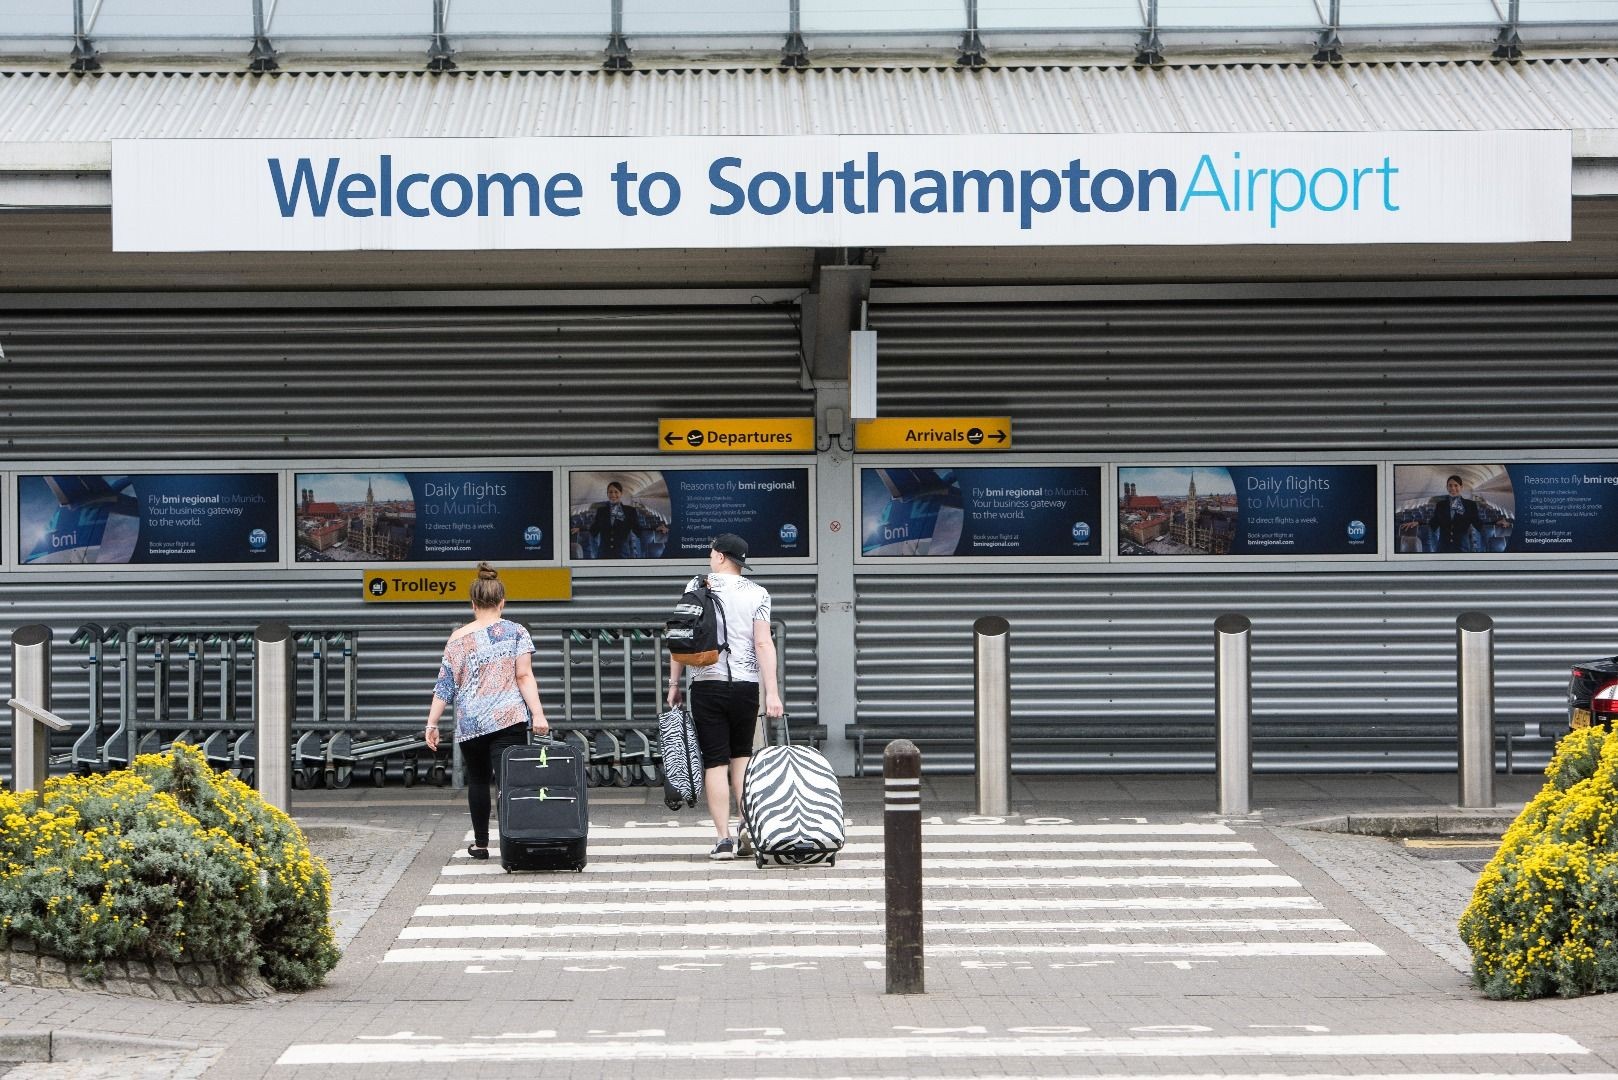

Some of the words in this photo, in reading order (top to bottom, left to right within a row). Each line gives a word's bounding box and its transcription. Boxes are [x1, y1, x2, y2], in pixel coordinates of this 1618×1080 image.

[267, 154, 583, 218] Welcome
[610, 161, 681, 217] to
[707, 431, 793, 446] Departures
[905, 429, 965, 442] Arrivals
[680, 481, 714, 490] Reasons
[716, 482, 725, 490] to
[726, 480, 736, 492] fly
[738, 480, 756, 490] bmi
[758, 480, 796, 492] regional.
[1248, 476, 1282, 494] Daily
[1286, 476, 1330, 494] flights
[1524, 475, 1558, 484] Reasons
[1560, 476, 1570, 484] to
[1571, 474, 1582, 486] fly
[1583, 474, 1602, 484] bmi
[424, 482, 460, 500] Daily
[463, 482, 507, 500] flights
[972, 488, 984, 498] Fly
[986, 488, 1004, 497] bmi
[1005, 488, 1042, 498] regional
[1054, 487, 1088, 496] Munich.
[148, 494, 160, 505] Fly
[162, 494, 180, 504] bmi
[182, 494, 220, 506] regional
[232, 494, 266, 504] Munich.
[972, 500, 992, 508] Your
[993, 499, 1029, 508] business
[1030, 500, 1066, 510] gateway
[1248, 498, 1262, 508] to
[1266, 494, 1324, 508] Munich.
[149, 506, 168, 515] Your
[170, 506, 206, 515] business
[207, 507, 244, 516] gateway
[424, 503, 440, 514] to
[443, 500, 501, 514] Munich.
[983, 511, 998, 519] the
[999, 510, 1025, 519] world.
[1275, 516, 1294, 525] flights
[149, 518, 158, 527] to
[160, 518, 174, 526] the
[175, 518, 202, 526] world.
[452, 523, 471, 532] flights
[524, 532, 540, 541] bmi
[780, 530, 797, 538] bmi
[884, 523, 908, 540] bmi
[1072, 528, 1089, 536] bmi
[1348, 526, 1364, 535] bmi
[52, 530, 77, 548] bmi
[250, 535, 266, 544] bmi
[392, 578, 457, 595] Trolleys
